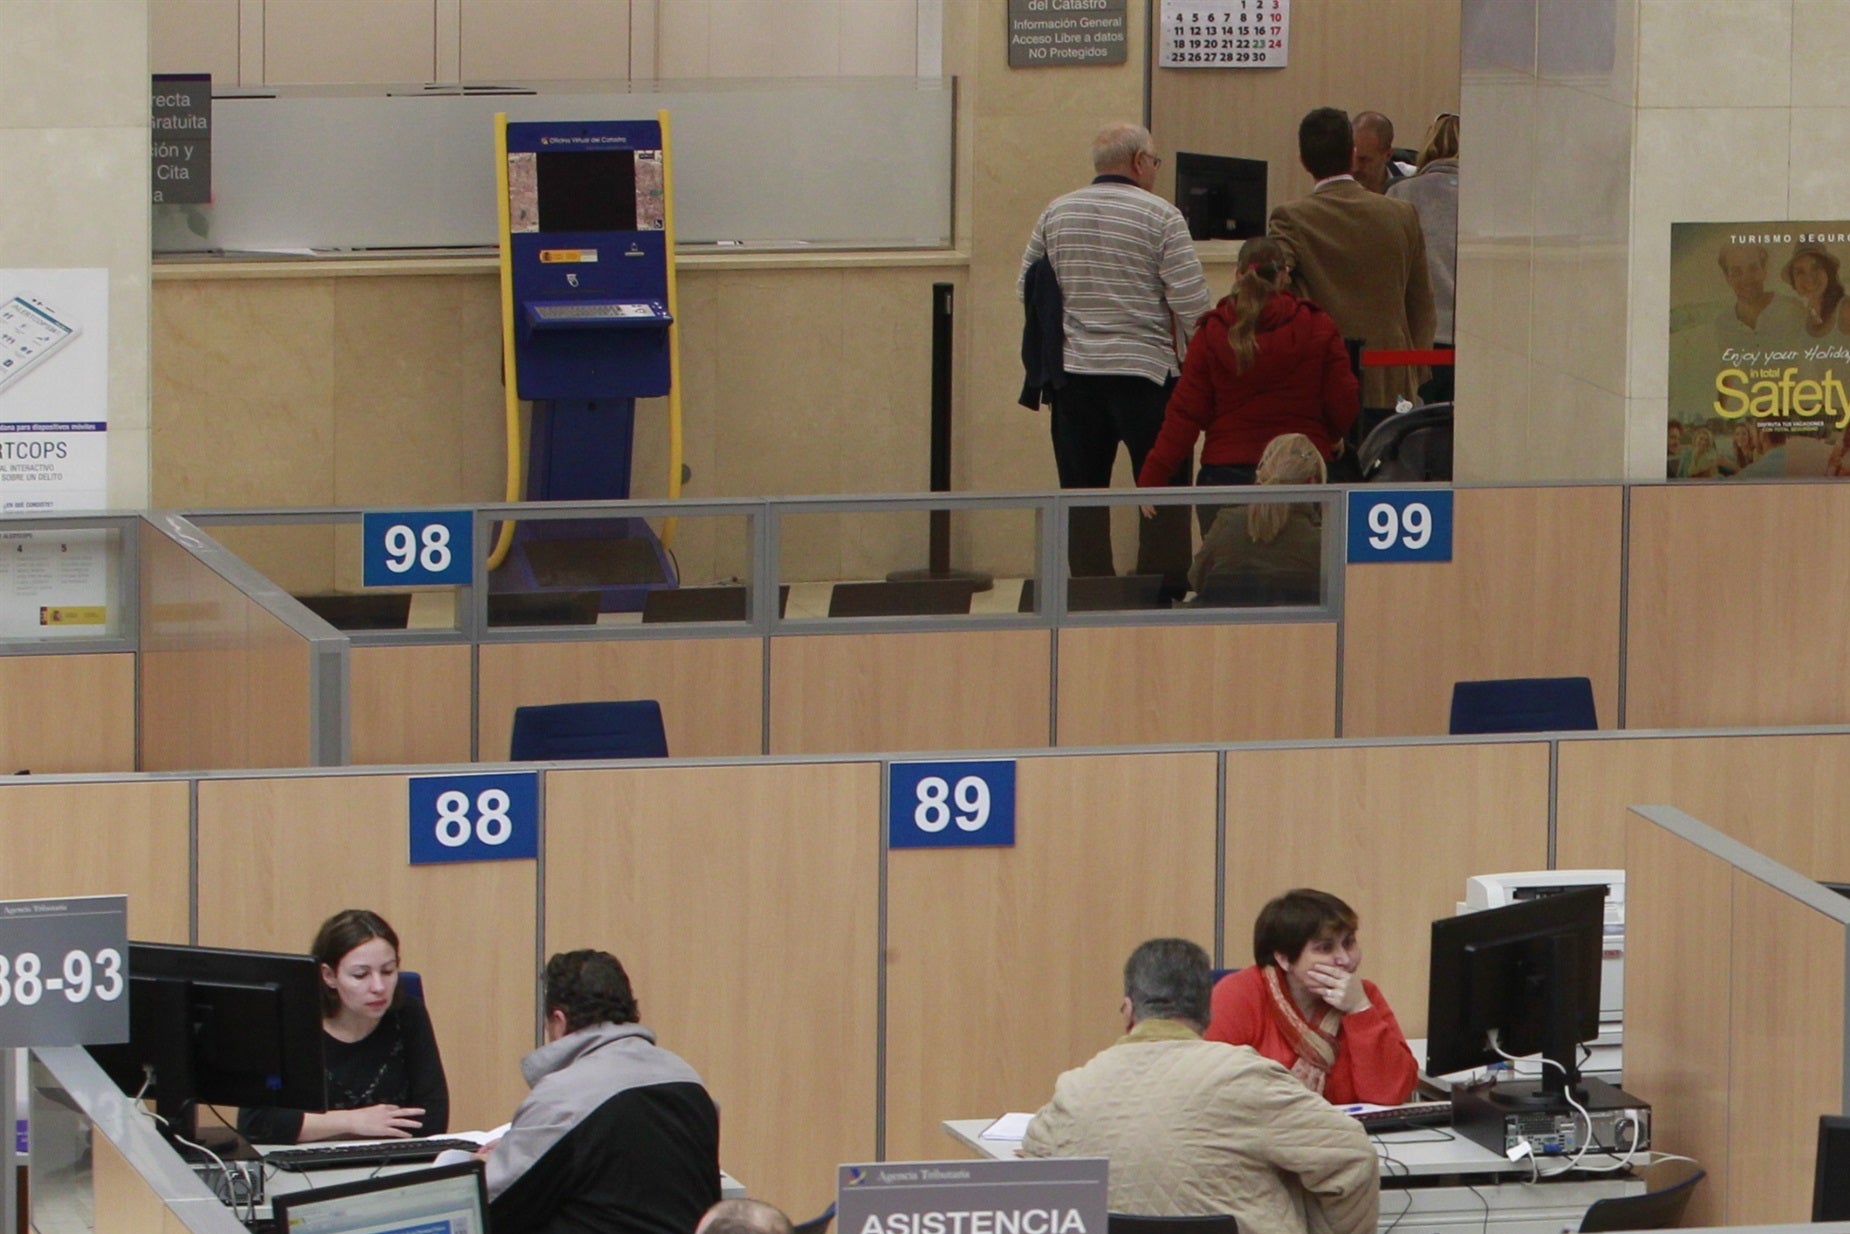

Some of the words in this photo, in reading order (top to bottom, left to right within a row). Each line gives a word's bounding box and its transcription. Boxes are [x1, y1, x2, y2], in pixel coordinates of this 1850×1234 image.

[1028, 0, 1048, 10] del
[1052, 0, 1106, 10] Catastro
[1242, 0, 1246, 9] 1
[1256, 0, 1263, 9] 2
[1272, 0, 1279, 9] 3
[1014, 18, 1077, 30] Información
[1080, 17, 1122, 28] General
[1176, 13, 1182, 22] 4
[1192, 13, 1198, 22] 5
[1208, 13, 1214, 22] 6
[1224, 13, 1230, 22] 7
[1240, 13, 1246, 22] 8
[1256, 13, 1263, 22] 9
[1270, 13, 1282, 22] 10
[1174, 26, 1184, 36] 11
[1190, 26, 1201, 36] 12
[1206, 26, 1217, 36] 13
[1222, 26, 1233, 36] 14
[1238, 26, 1250, 36] 15
[1254, 26, 1266, 36] 16
[1270, 26, 1281, 36] 17
[1012, 34, 1052, 44] Acceso
[1054, 33, 1082, 43] Libre
[1094, 32, 1124, 42] datos
[1174, 40, 1185, 48] 18
[1190, 40, 1201, 48] 19
[1204, 40, 1218, 48] 20
[1222, 40, 1233, 48] 21
[1236, 40, 1250, 48] 22
[1252, 40, 1265, 48] 23
[1268, 40, 1281, 48] 24
[1028, 48, 1047, 59] NO
[1050, 46, 1108, 60] Protegidos
[1172, 53, 1185, 62] 25
[1188, 53, 1201, 62] 26
[1204, 53, 1217, 62] 27
[1220, 53, 1233, 62] 28
[1236, 53, 1249, 62] 29
[1252, 53, 1266, 62] 30
[152, 142, 179, 158] ión
[184, 146, 194, 160] y
[157, 164, 190, 180] Cita
[1730, 234, 1792, 244] TURISMO
[1722, 348, 1761, 367] Enjoy
[1764, 350, 1798, 364] your
[1750, 369, 1758, 378] in
[1760, 368, 1780, 378] total
[0, 441, 67, 459] TCOPS
[10, 464, 54, 472] INTERACTIVO
[1, 473, 24, 481] SOBRE
[1368, 503, 1432, 550] 99
[385, 524, 451, 573] 98
[914, 776, 990, 832] 89
[435, 789, 512, 847] 88
[878, 1171, 918, 1184] Agencia
[920, 1169, 970, 1180] Tributaria
